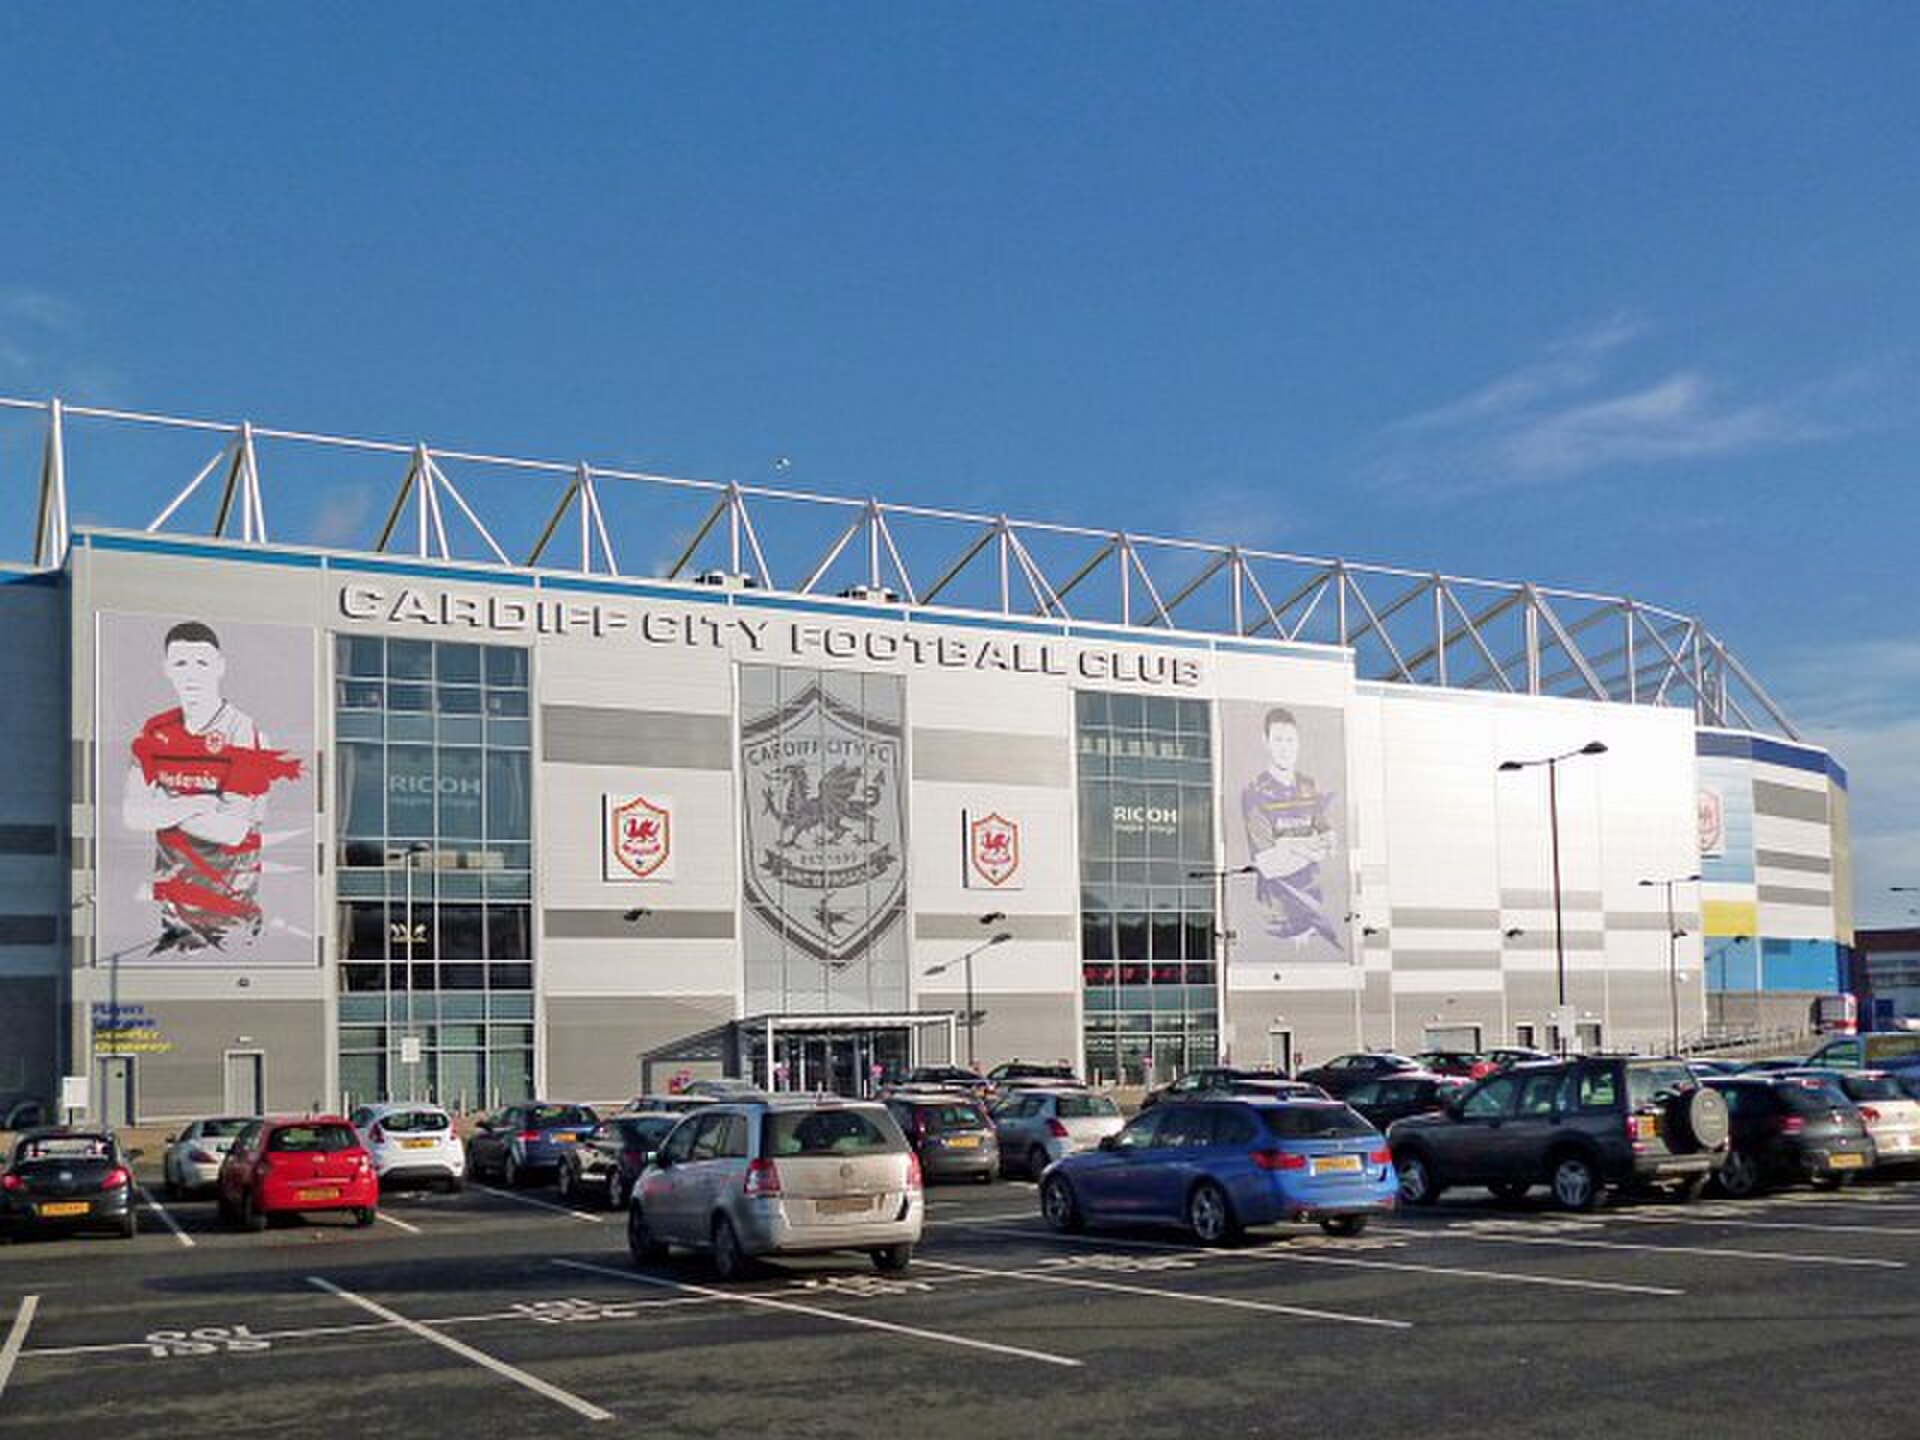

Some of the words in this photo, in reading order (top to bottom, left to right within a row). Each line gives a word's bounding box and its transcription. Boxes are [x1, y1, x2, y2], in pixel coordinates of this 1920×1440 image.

[339, 583, 629, 638] CARDIFF
[642, 612, 769, 651] CITY
[791, 622, 1068, 676] FOOTBALL
[1078, 649, 1203, 687] CLUB
[389, 775, 481, 793] RICOH
[1112, 805, 1177, 824] RICOH
